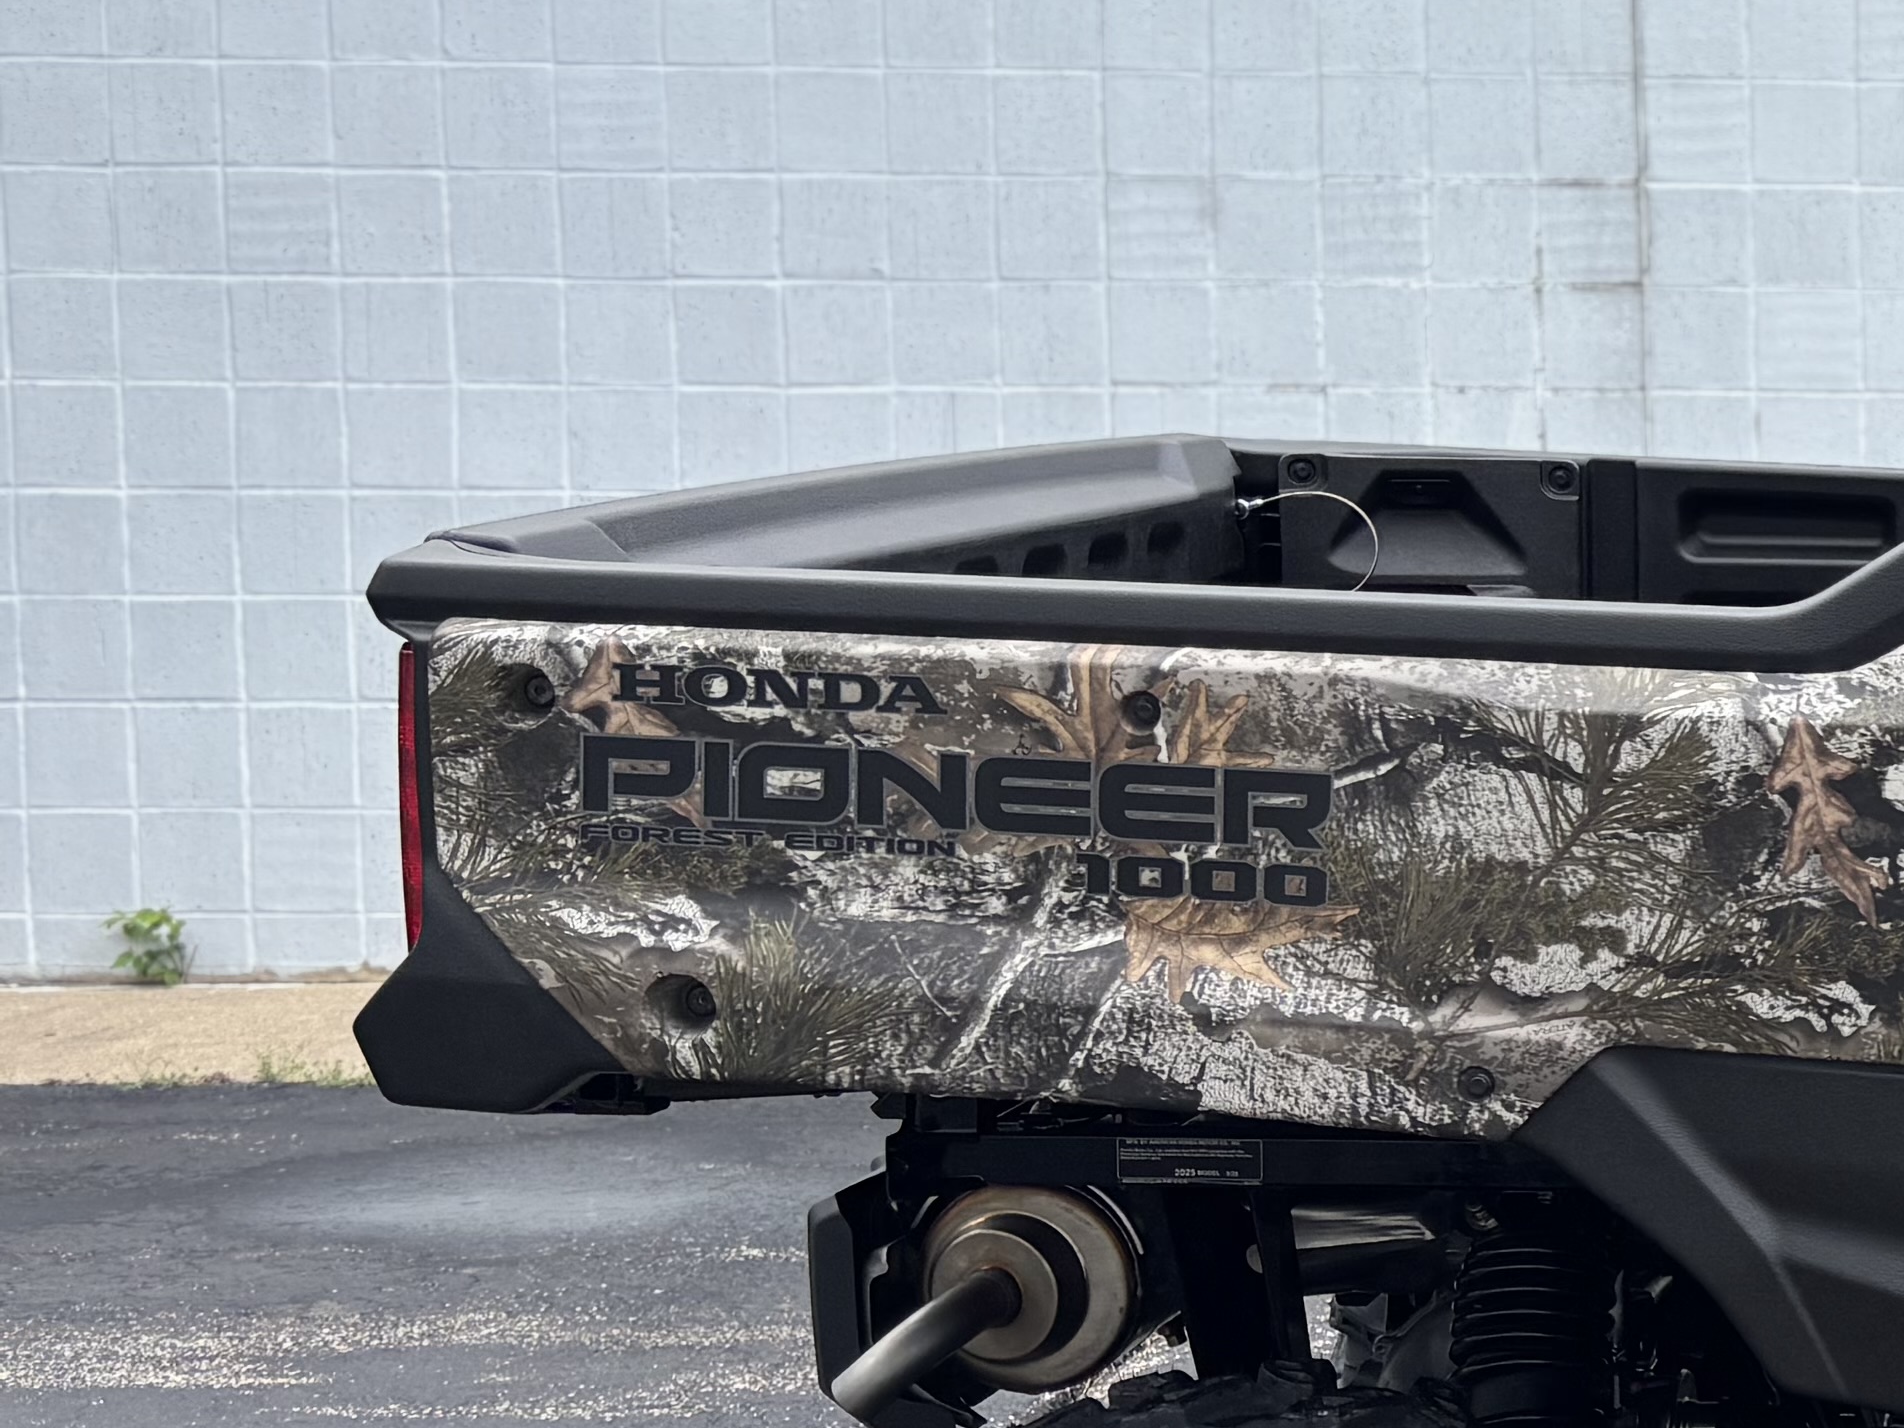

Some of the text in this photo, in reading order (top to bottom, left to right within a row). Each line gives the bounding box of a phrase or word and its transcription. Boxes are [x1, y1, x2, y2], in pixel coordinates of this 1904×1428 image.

[609, 661, 948, 716] HONDA
[579, 731, 1335, 851] PIONEER
[578, 822, 959, 857] FOREST EDITION
[1075, 852, 1330, 907] 1000
